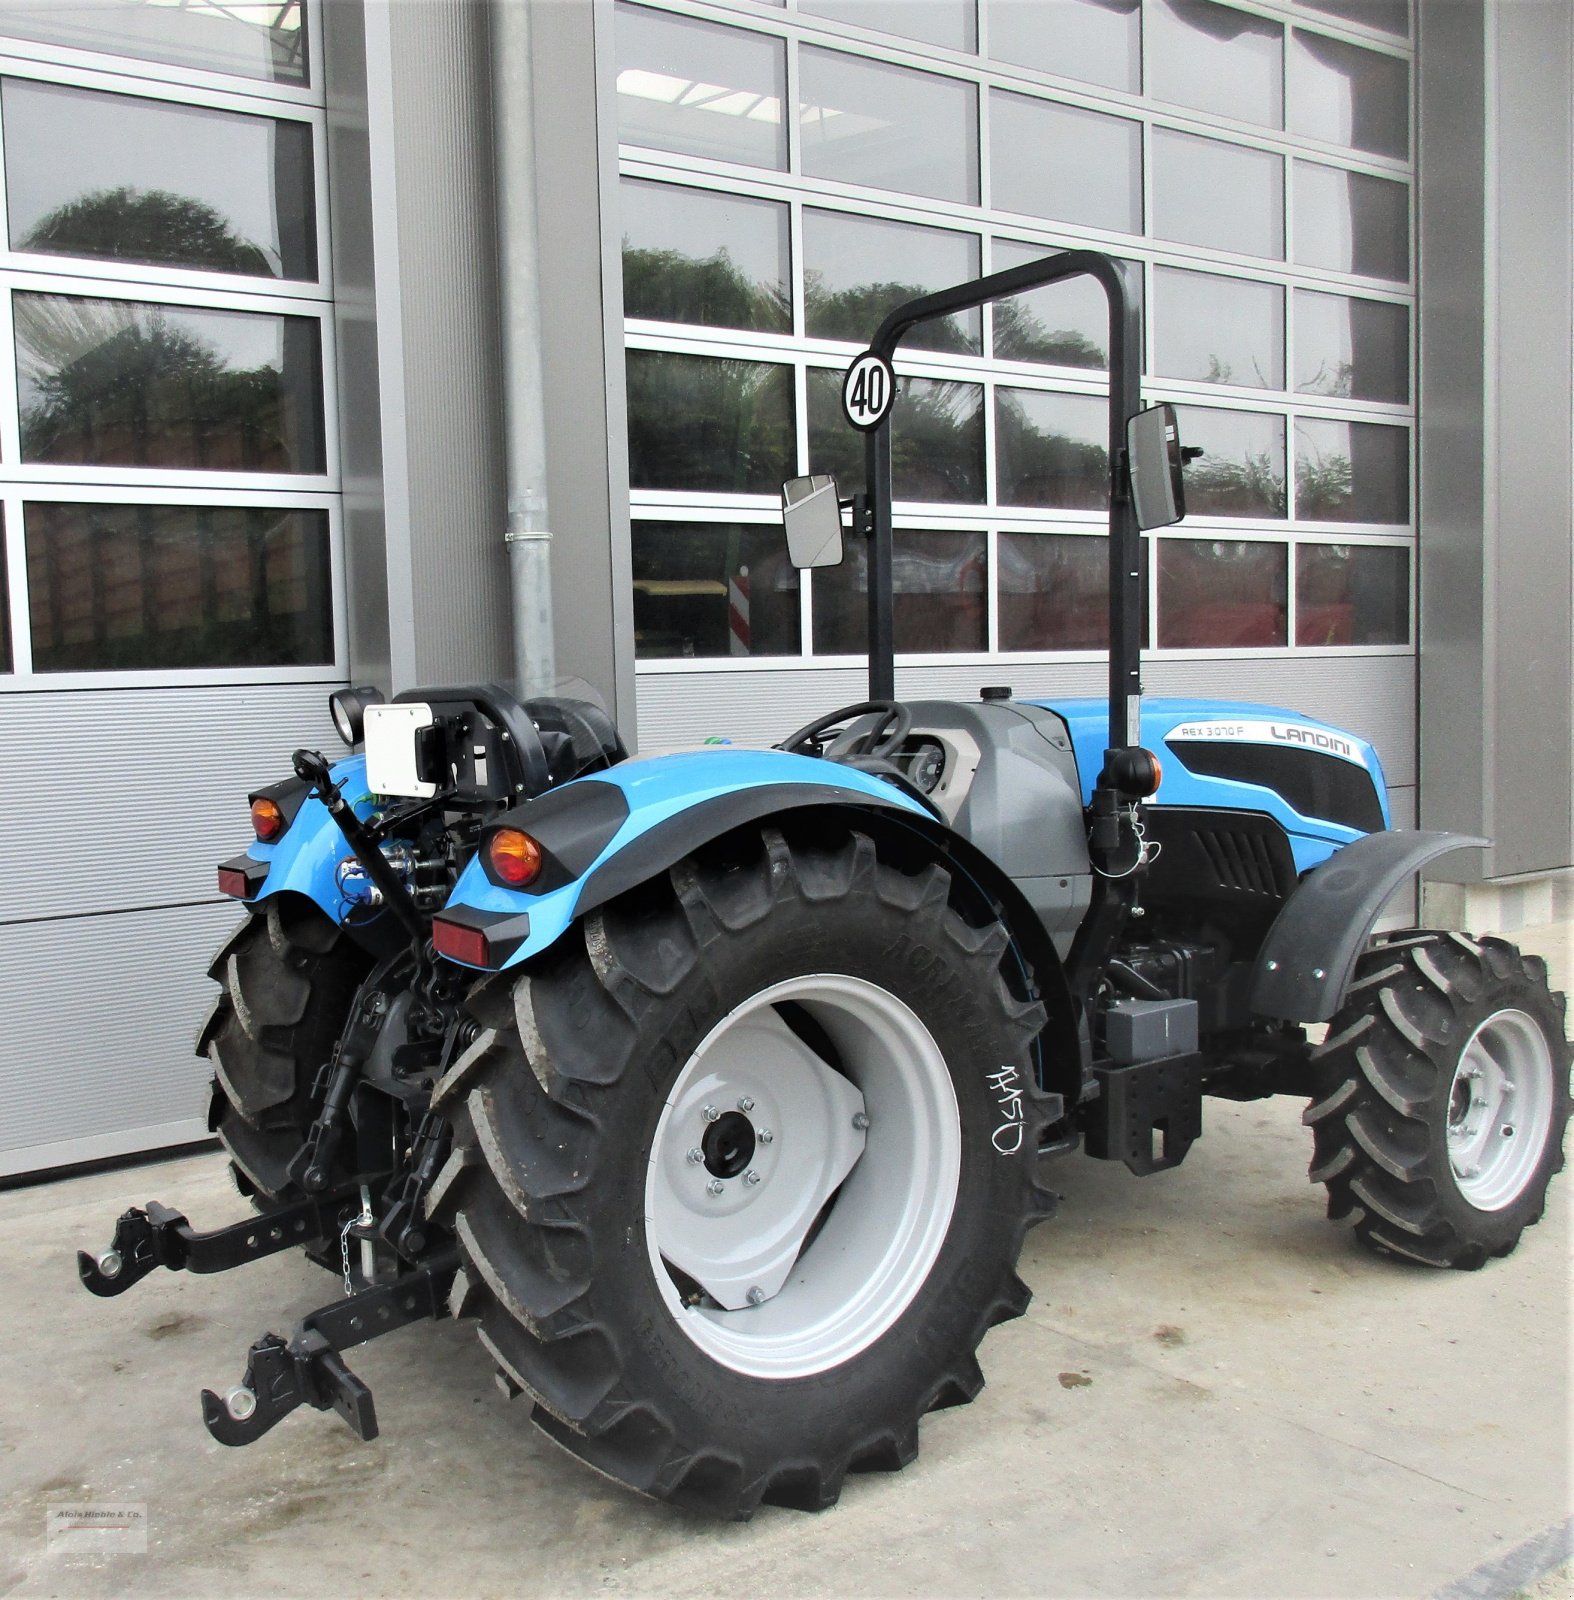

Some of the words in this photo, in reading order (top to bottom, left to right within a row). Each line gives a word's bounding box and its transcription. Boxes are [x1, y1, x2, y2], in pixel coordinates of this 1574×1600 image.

[850, 365, 884, 417] 40
[1181, 728, 1203, 737] REX
[1237, 726, 1244, 736] F
[1270, 726, 1351, 756] LANDINI
